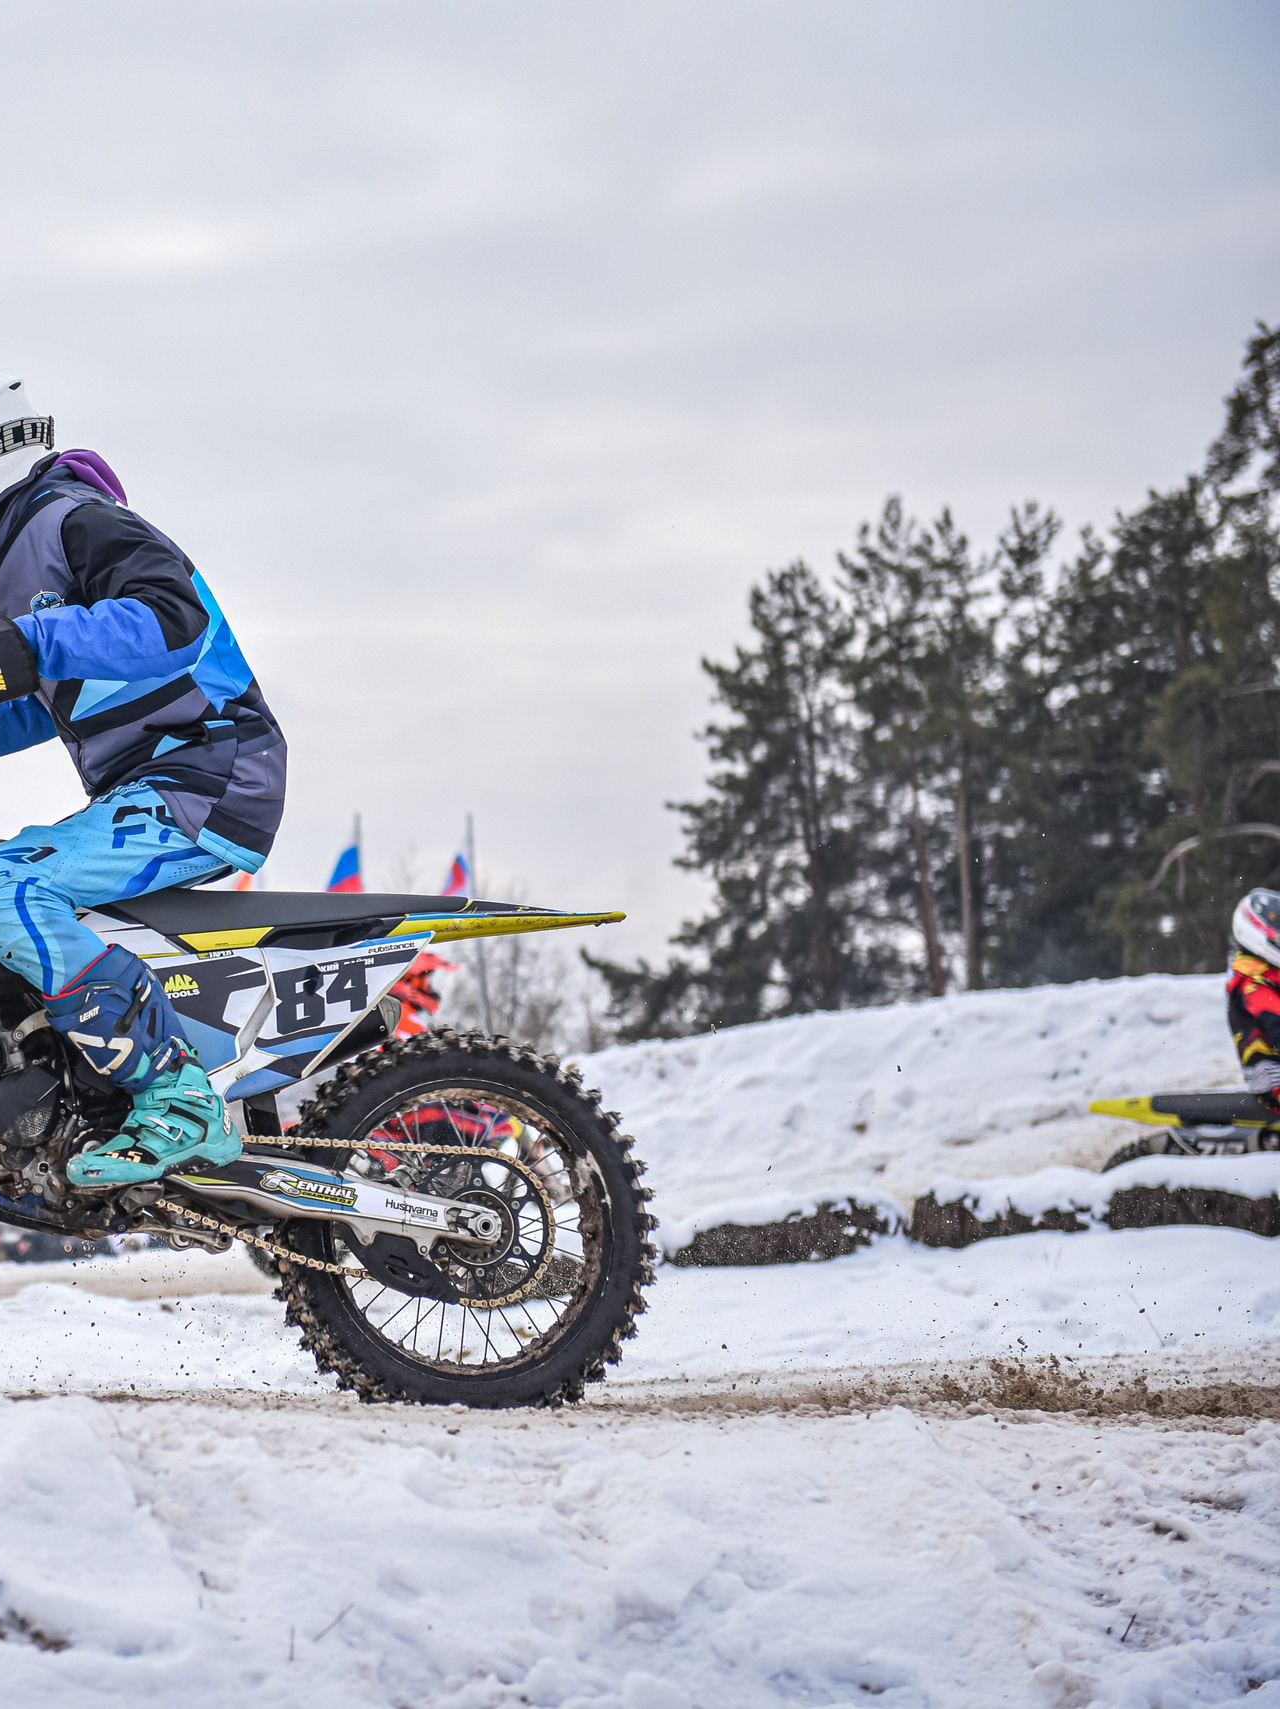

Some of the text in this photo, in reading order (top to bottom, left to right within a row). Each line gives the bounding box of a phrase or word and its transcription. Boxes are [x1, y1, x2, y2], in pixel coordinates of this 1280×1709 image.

[164, 973, 199, 993] MAC
[166, 988, 201, 1000] TOOLS
[274, 963, 369, 1036] 84
[385, 1199, 439, 1218] Husqvarna
